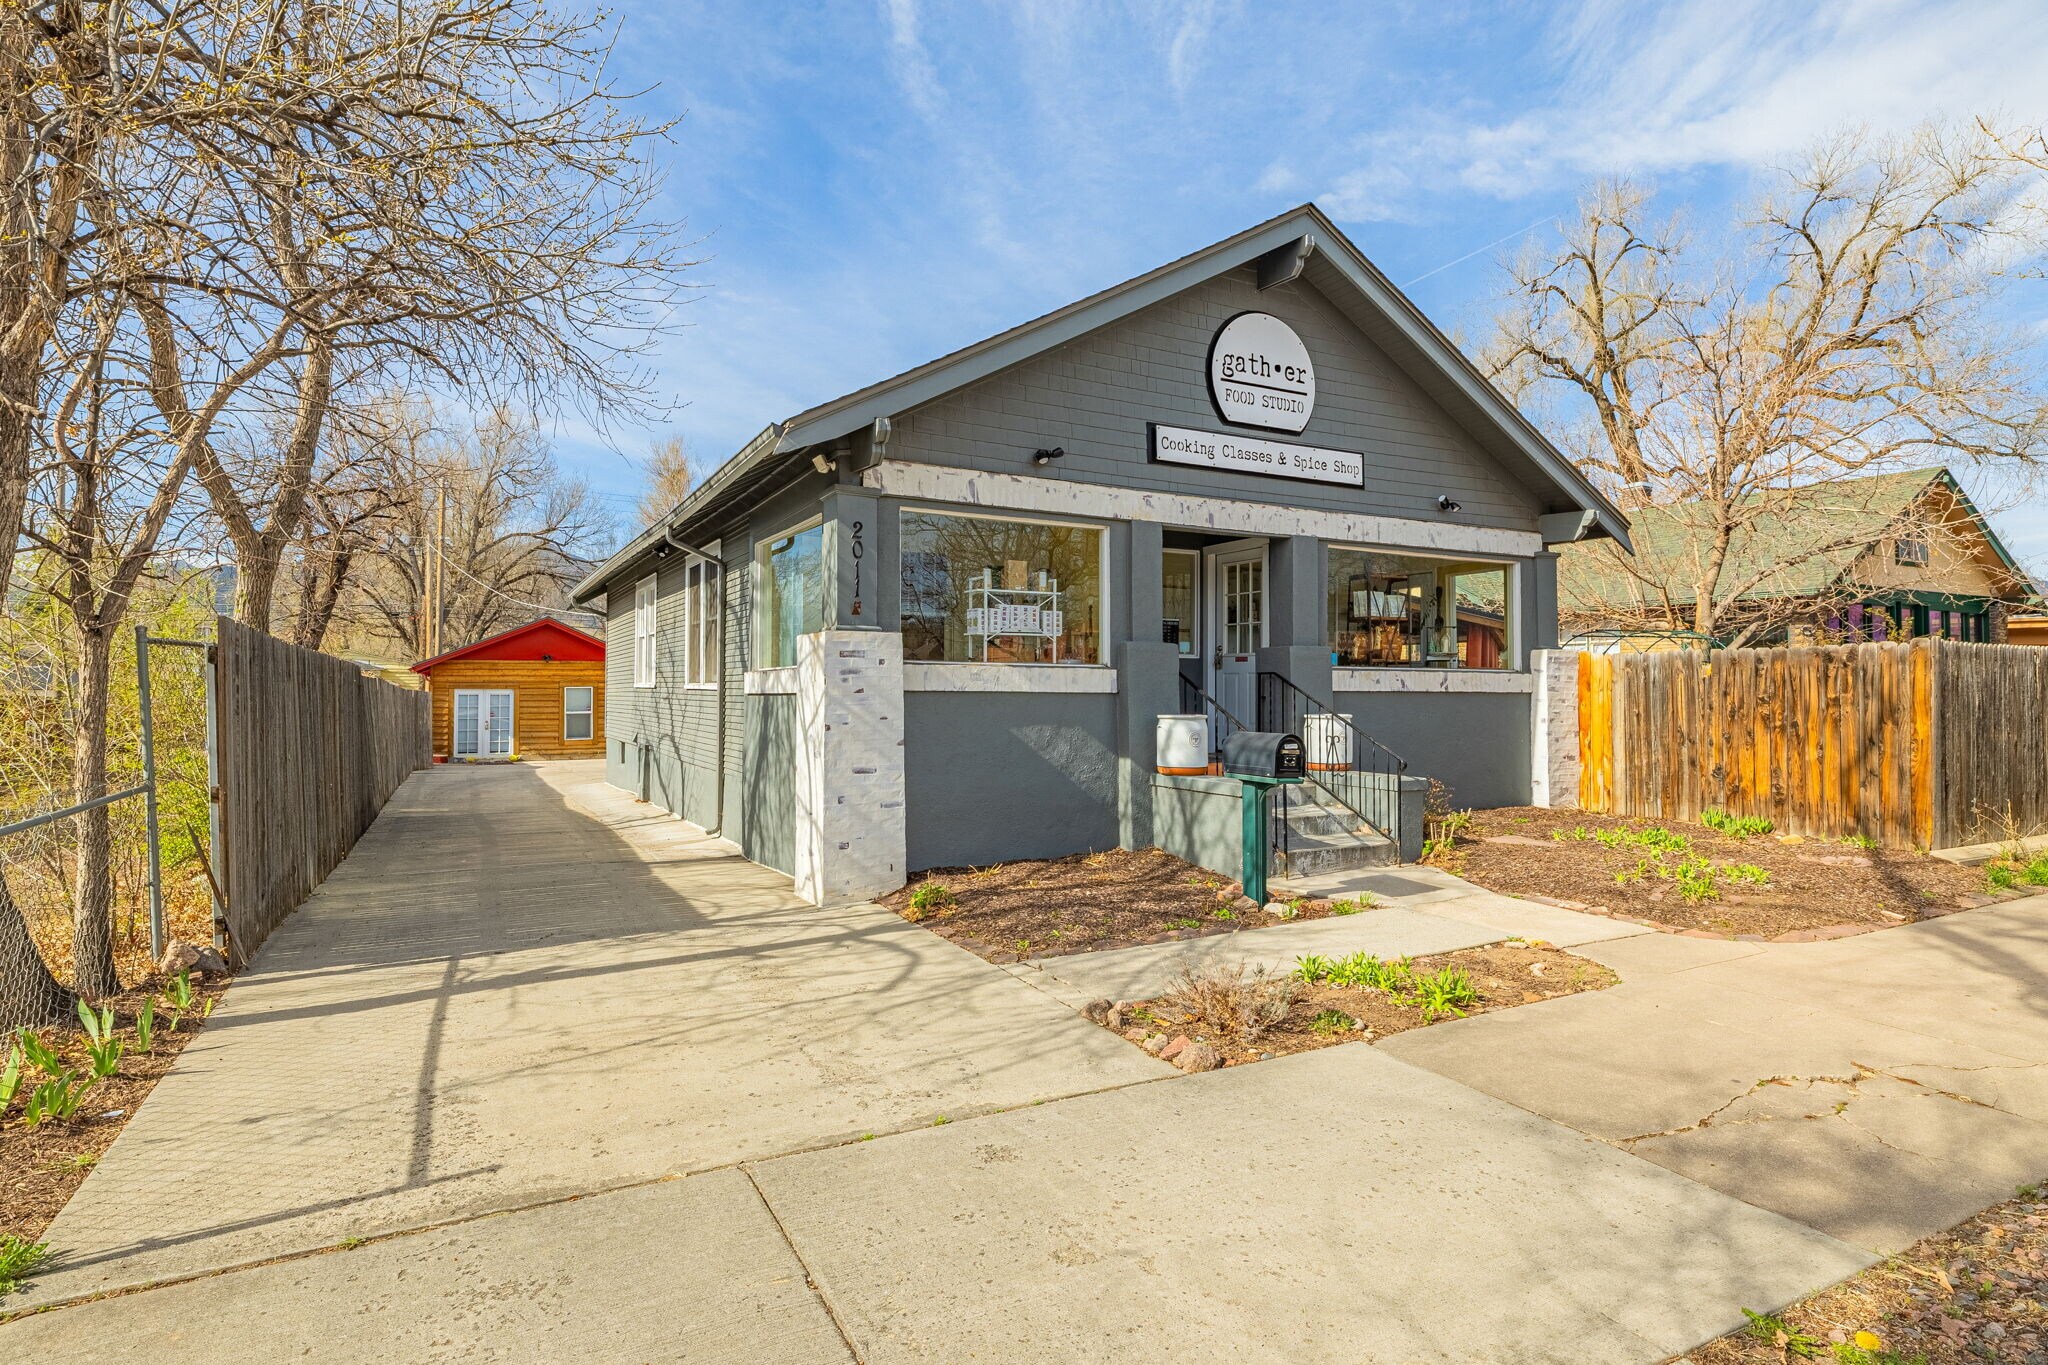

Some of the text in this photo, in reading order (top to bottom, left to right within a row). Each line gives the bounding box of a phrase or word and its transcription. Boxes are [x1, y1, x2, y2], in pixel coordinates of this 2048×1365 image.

[1225, 388, 1305, 414] FOOD STUDIO
[1161, 436, 1360, 478] Cooking Classes & Spice Shop
[851, 521, 864, 598] 2011
